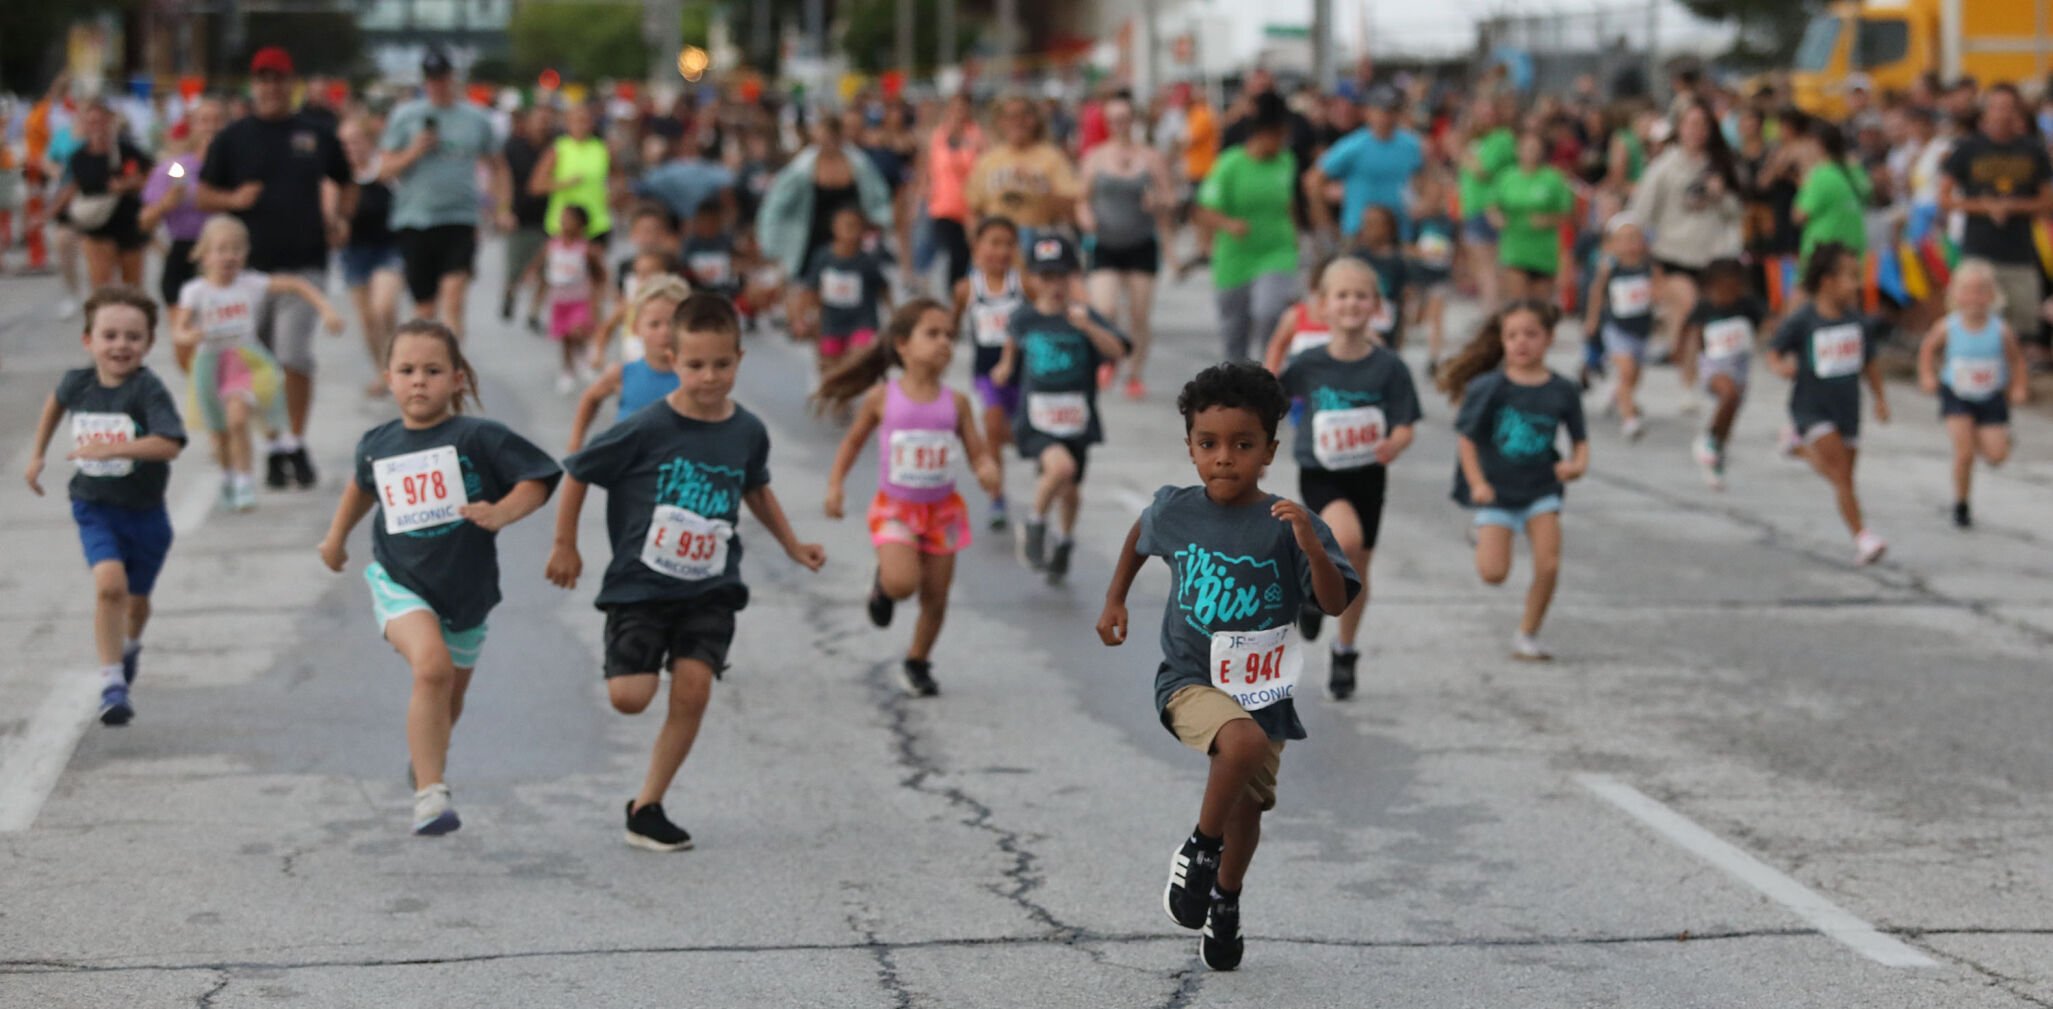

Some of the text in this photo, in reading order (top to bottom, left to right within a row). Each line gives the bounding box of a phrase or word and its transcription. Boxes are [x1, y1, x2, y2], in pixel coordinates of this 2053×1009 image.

[385, 470, 448, 507] E 978
[655, 527, 717, 561] E 933
[1193, 575, 1260, 625] Bix
[1220, 644, 1285, 685] E 947
